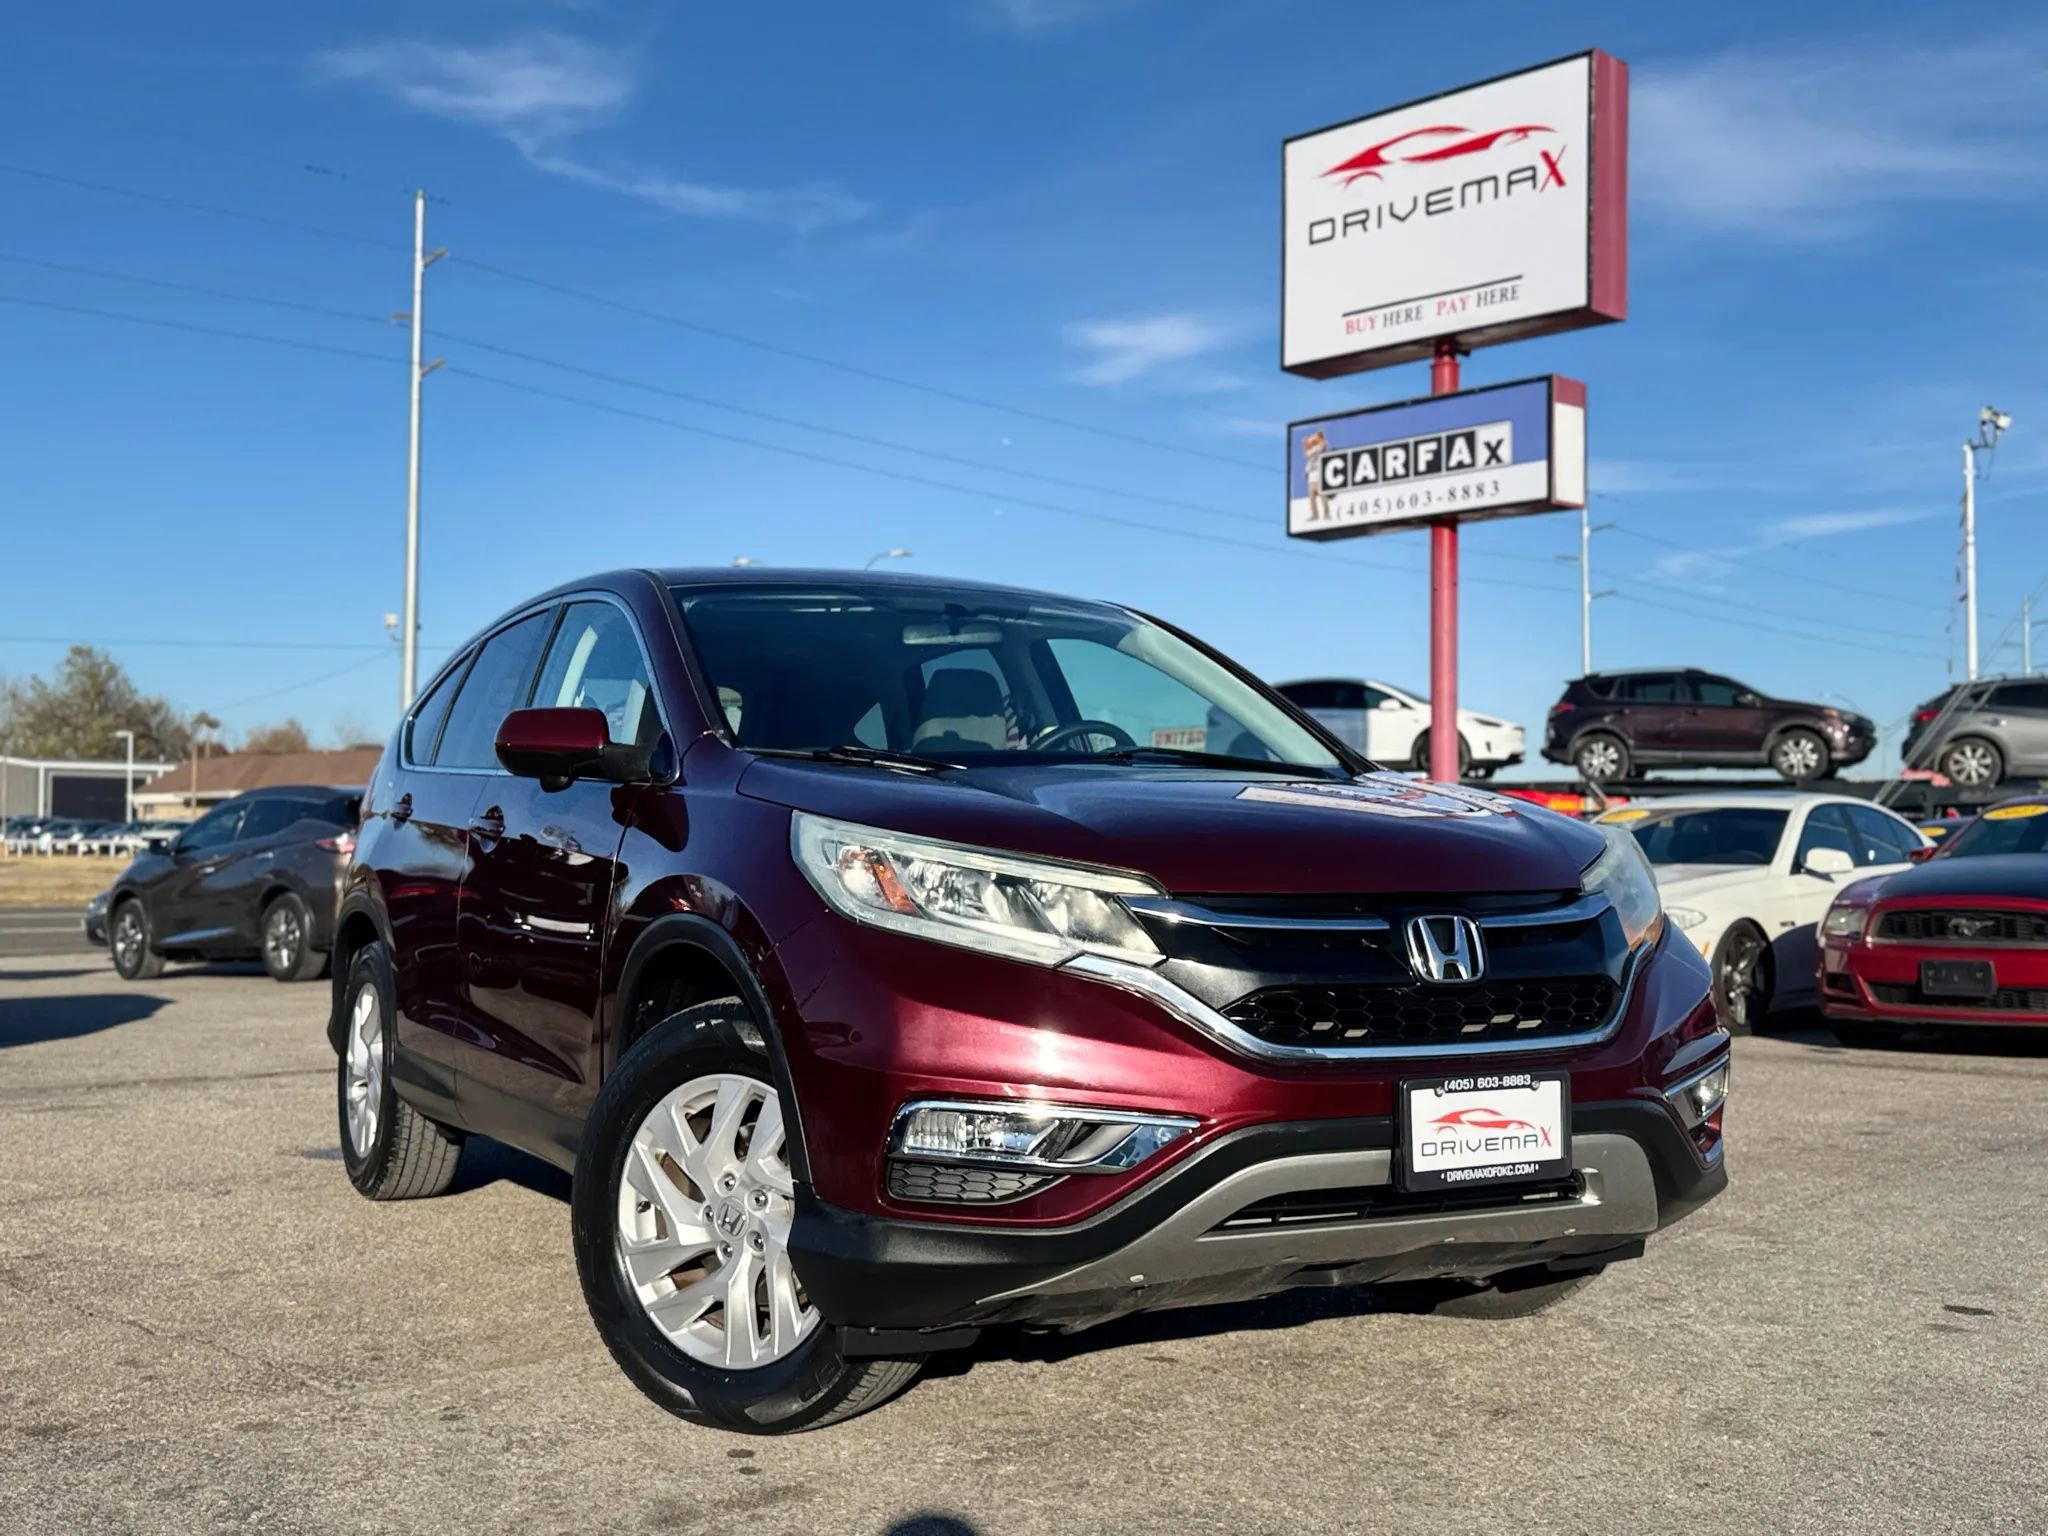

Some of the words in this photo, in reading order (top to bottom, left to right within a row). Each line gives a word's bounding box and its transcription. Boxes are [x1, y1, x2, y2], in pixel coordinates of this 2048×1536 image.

[1309, 144, 1567, 246] DRIVEMAX
[1344, 314, 1379, 335] BUY
[1382, 306, 1424, 328] HERE
[1436, 295, 1470, 317] PAY
[1476, 284, 1520, 308] HERE
[1323, 436, 1504, 487] CARFAX
[1335, 480, 1500, 519] (405)603-8883
[1444, 1078, 1474, 1091] (405)
[1477, 1074, 1531, 1089] 603-8883
[1421, 1126, 1552, 1157] DRIVEMAX
[1446, 1163, 1534, 1182] DRIVEMAXOFOKC.COM
